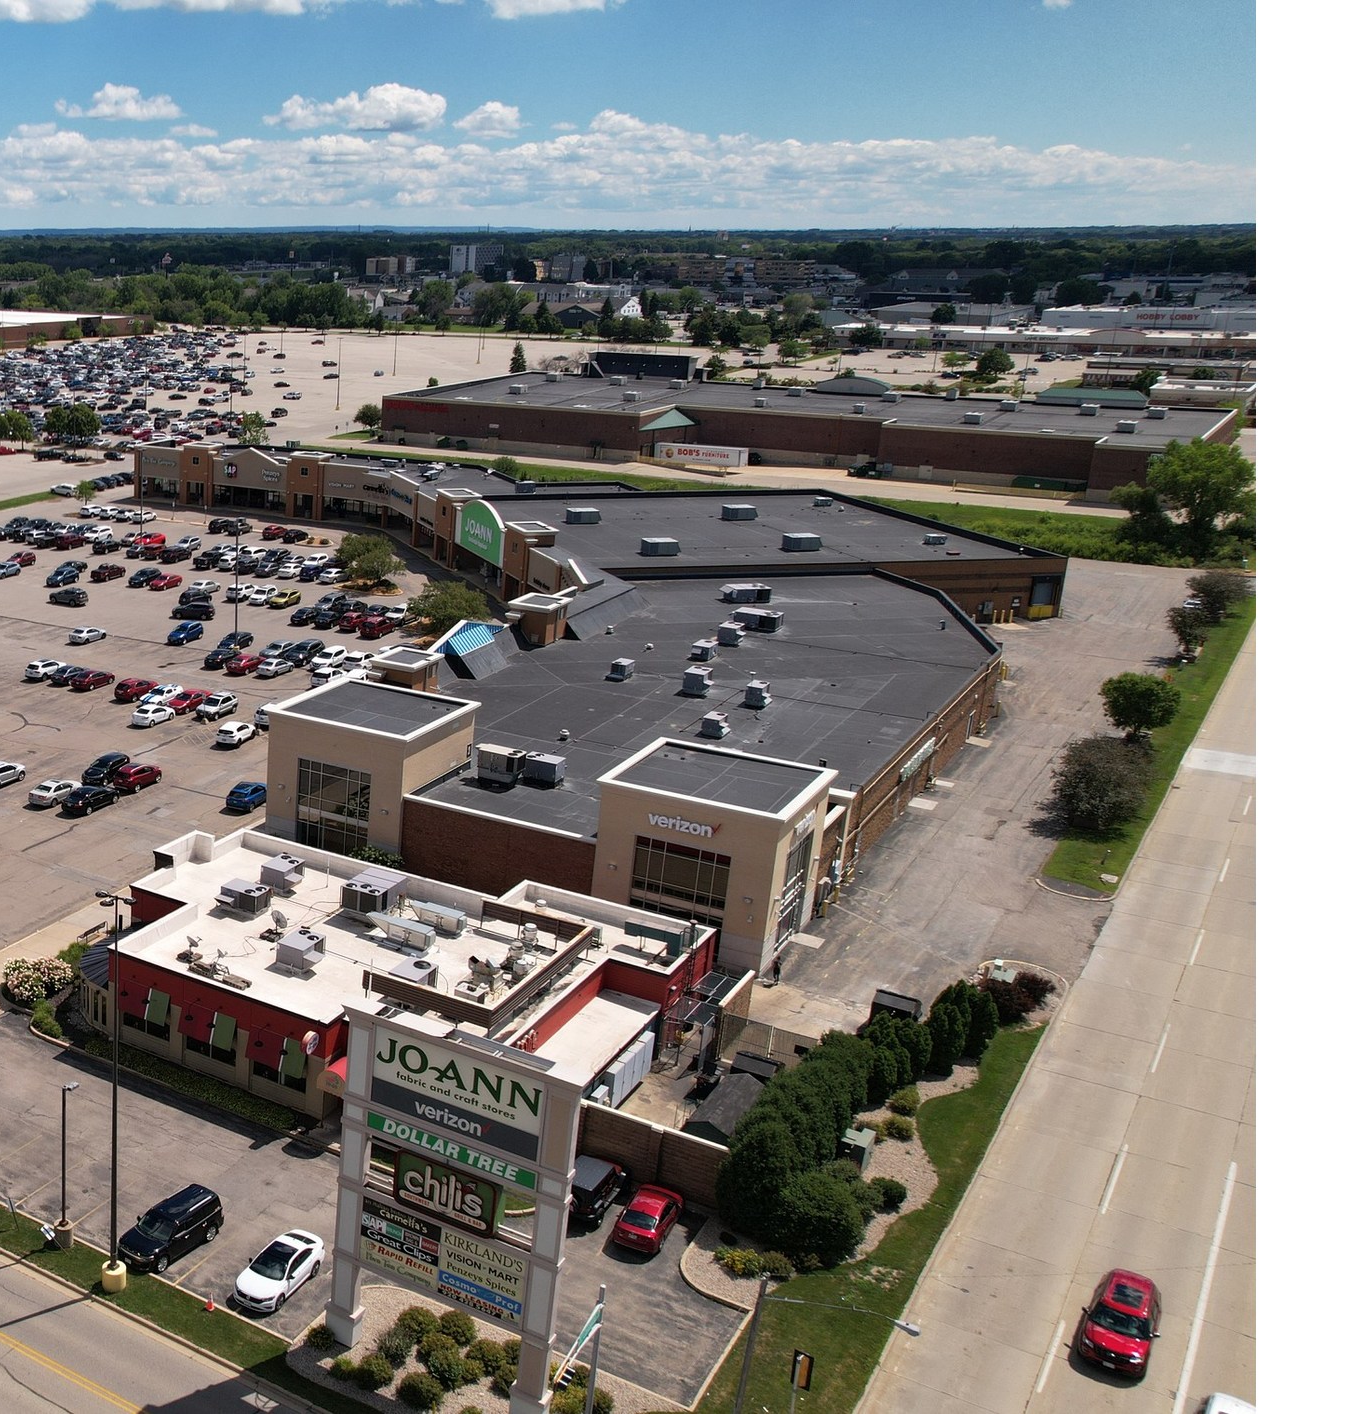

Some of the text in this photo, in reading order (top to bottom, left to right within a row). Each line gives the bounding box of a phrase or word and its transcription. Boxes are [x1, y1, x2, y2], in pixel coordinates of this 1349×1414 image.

[1137, 313, 1166, 321] HOBBY
[677, 448, 700, 457] BOB'S
[465, 518, 493, 544] JOANN
[648, 813, 713, 838] verizon
[396, 1070, 516, 1120] fabric and craft stores
[415, 1101, 482, 1137] verizon
[382, 1119, 519, 1182] DOLLAR TREE
[404, 1165, 483, 1217] chili's
[367, 1229, 432, 1262] Great Clips
[377, 1245, 434, 1275] RAPID REFILL
[444, 1232, 523, 1273] KIRKLAND'S
[446, 1249, 482, 1270] VISION
[488, 1267, 520, 1285] MART
[446, 1262, 517, 1297] Penzeys Spices
[440, 1284, 504, 1314] NOW LEASING
[442, 1273, 519, 1311] Cosmo Prof
